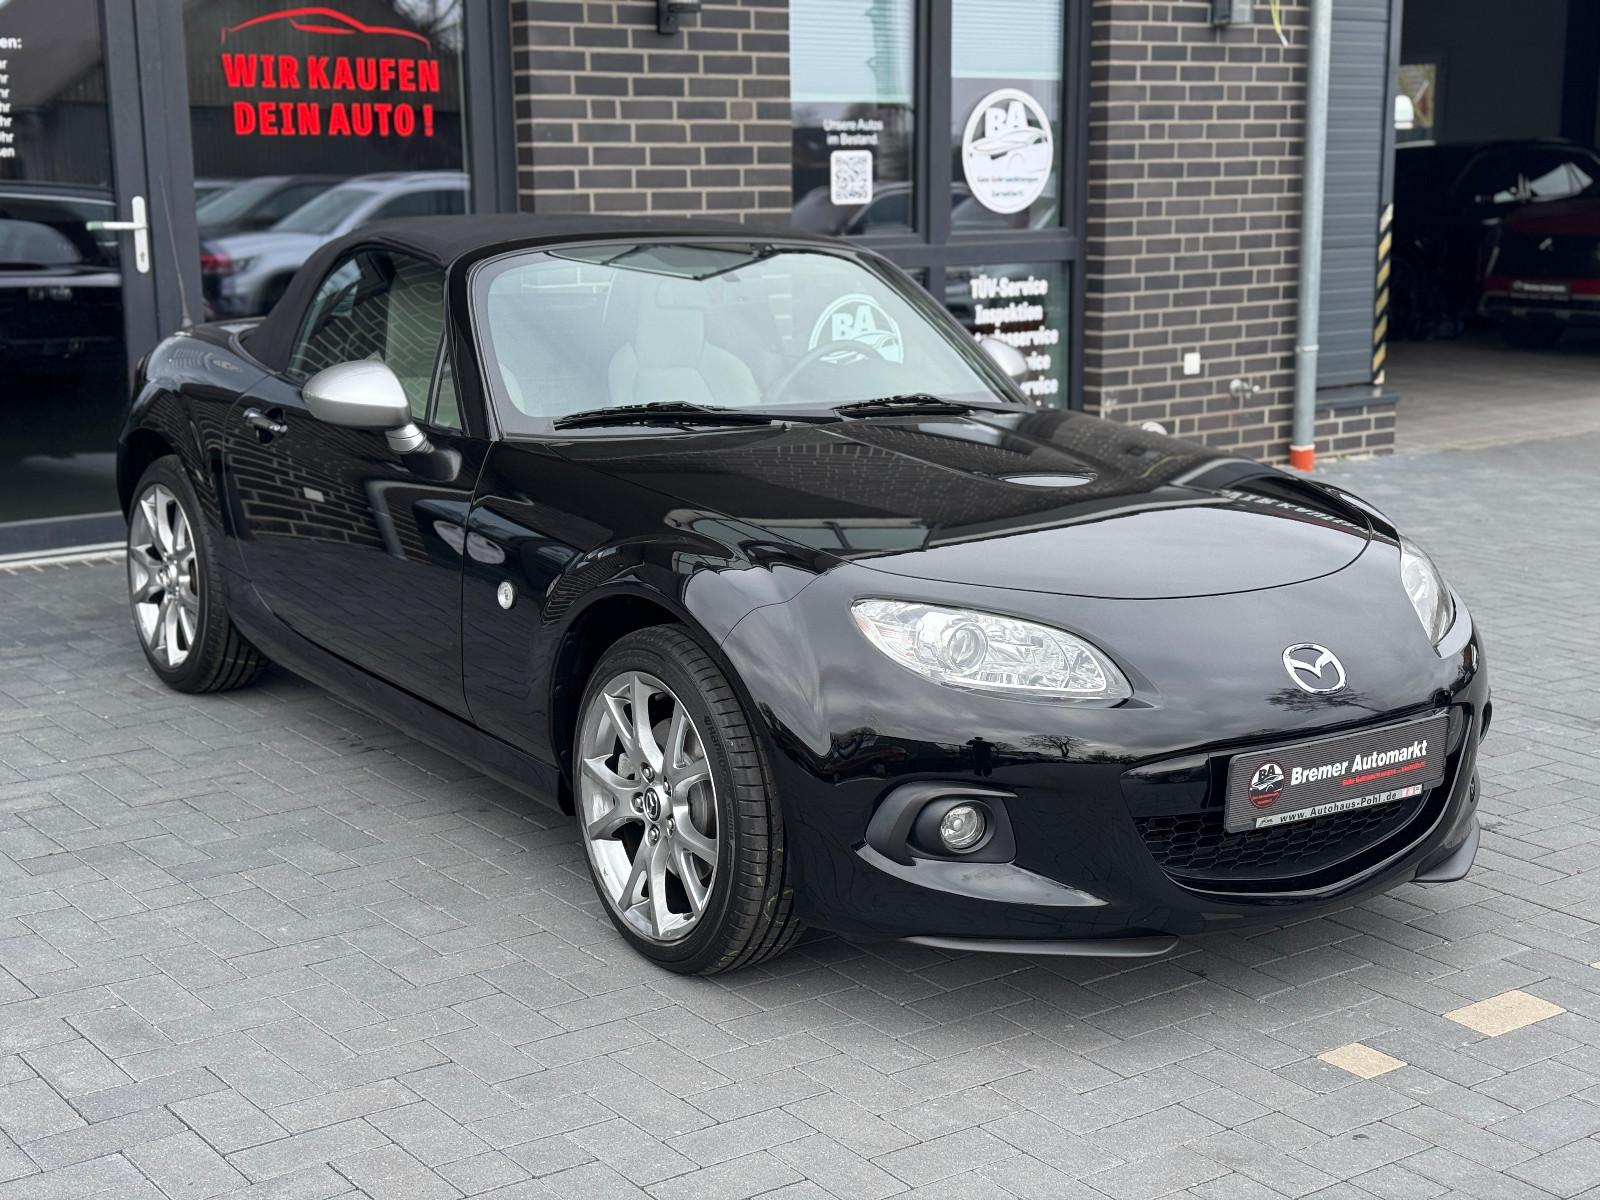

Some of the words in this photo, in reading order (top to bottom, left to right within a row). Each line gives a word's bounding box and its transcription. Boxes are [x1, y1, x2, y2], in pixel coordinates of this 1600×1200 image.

[221, 53, 300, 88] WIR
[306, 56, 440, 92] KAUFEN
[233, 101, 320, 135] DEIN
[328, 102, 415, 136] AUTO
[1291, 760, 1349, 786] Bremer
[1351, 739, 1428, 773] Automarkt
